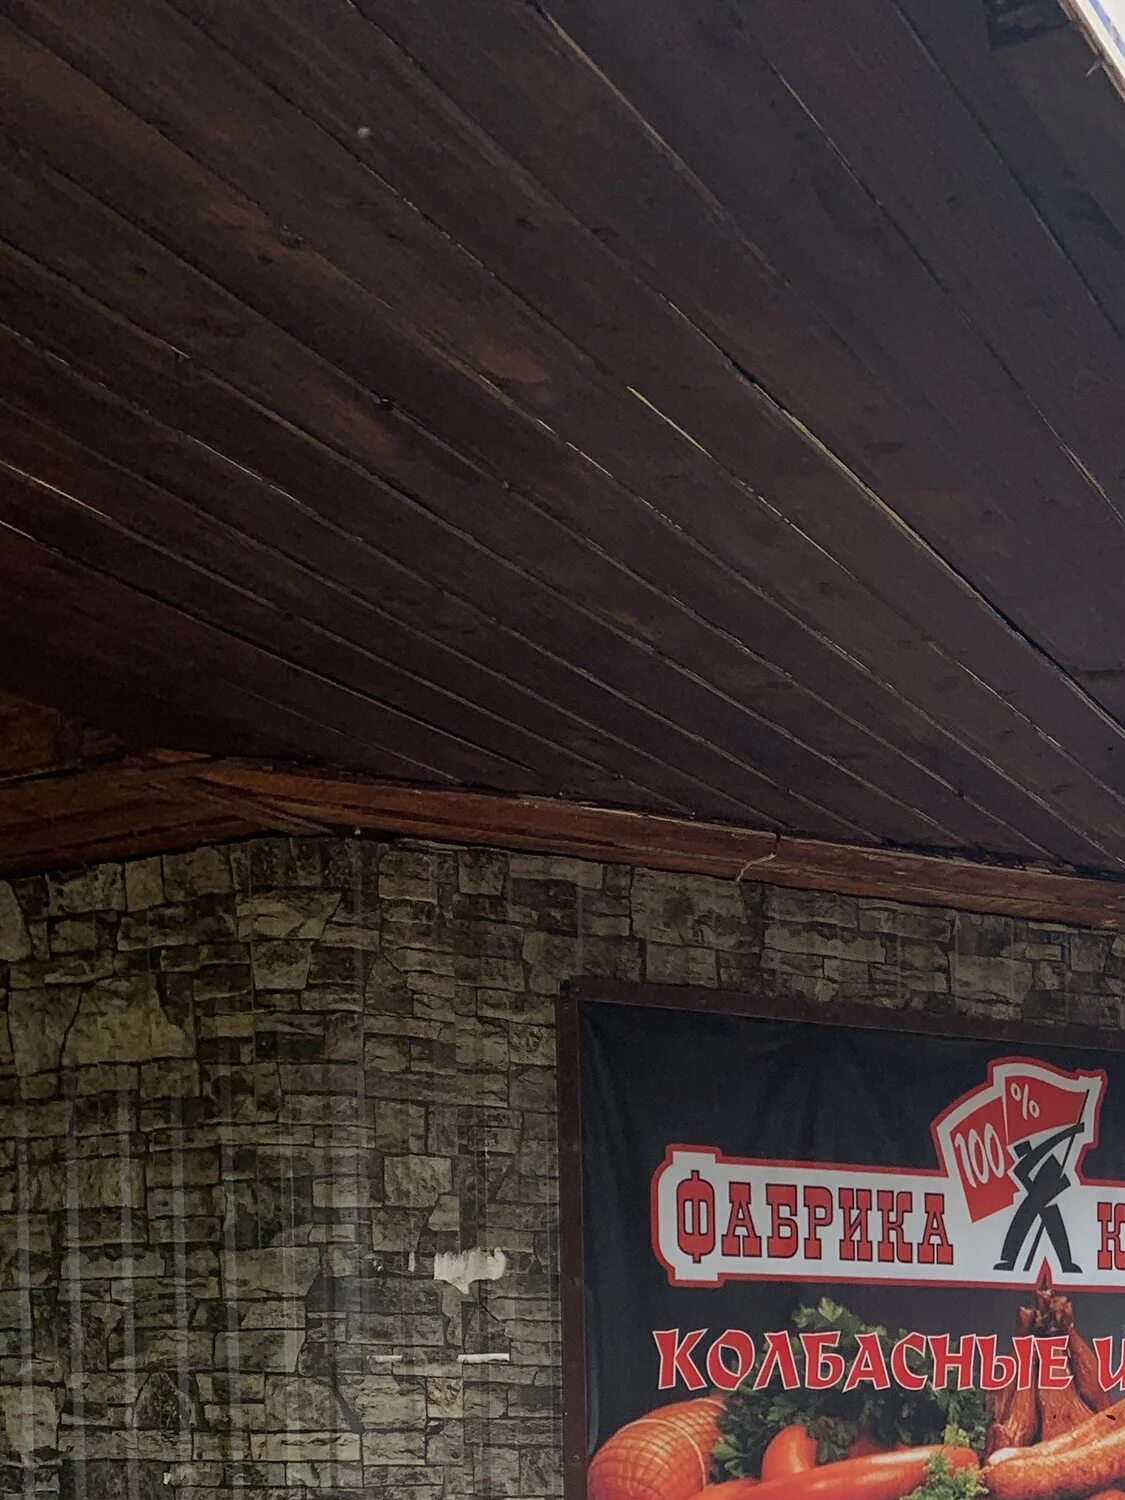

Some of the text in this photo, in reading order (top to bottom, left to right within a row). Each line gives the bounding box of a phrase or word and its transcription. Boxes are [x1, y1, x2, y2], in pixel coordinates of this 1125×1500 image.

[953, 1081, 1041, 1189] 100 %
[675, 1169, 955, 1266] ФАБРИКА
[651, 1327, 1075, 1393] КОЛБАСНЫЕ
